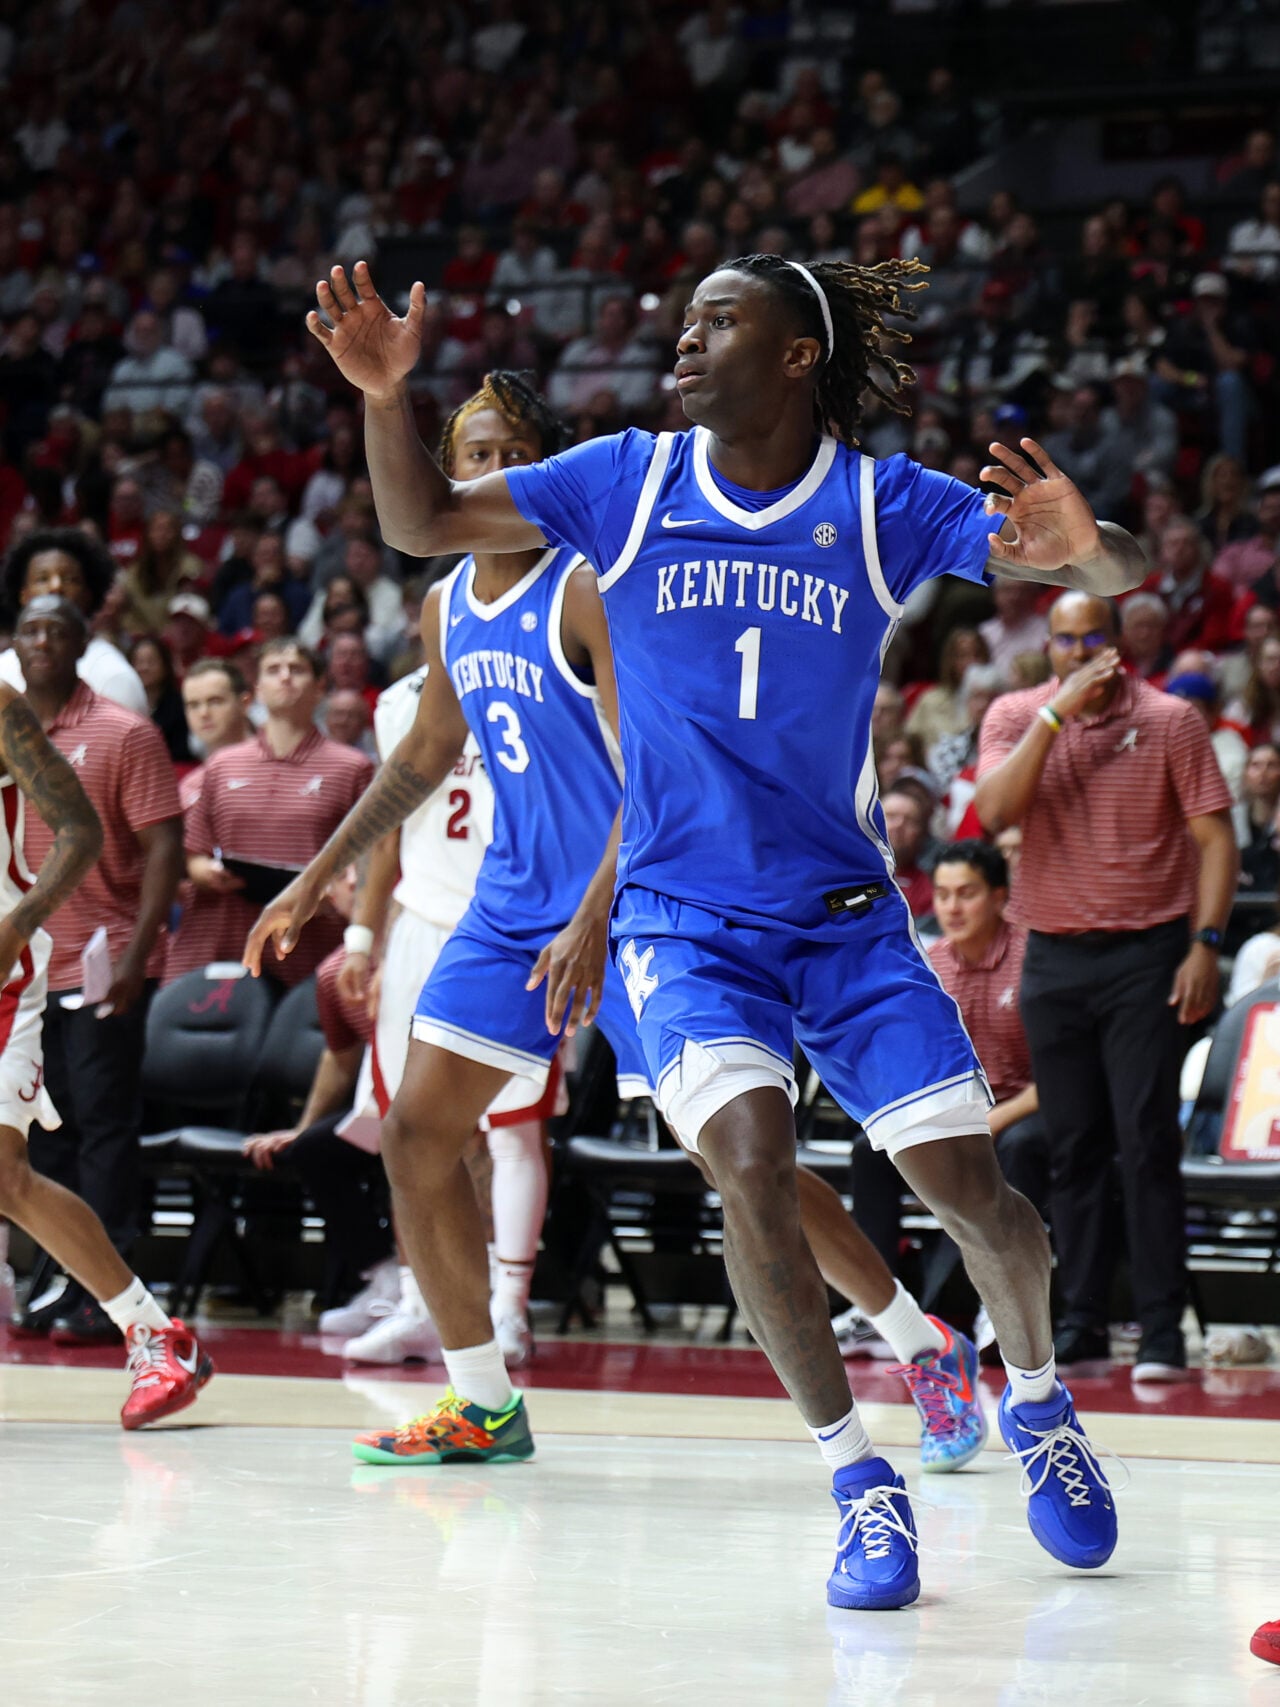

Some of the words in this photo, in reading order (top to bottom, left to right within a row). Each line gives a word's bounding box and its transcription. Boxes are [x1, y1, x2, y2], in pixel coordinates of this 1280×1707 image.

[814, 524, 835, 545] SEC
[656, 561, 849, 634] KENTUCKY
[734, 626, 762, 720] 1
[486, 701, 530, 774] 3
[447, 788, 471, 839] 2
